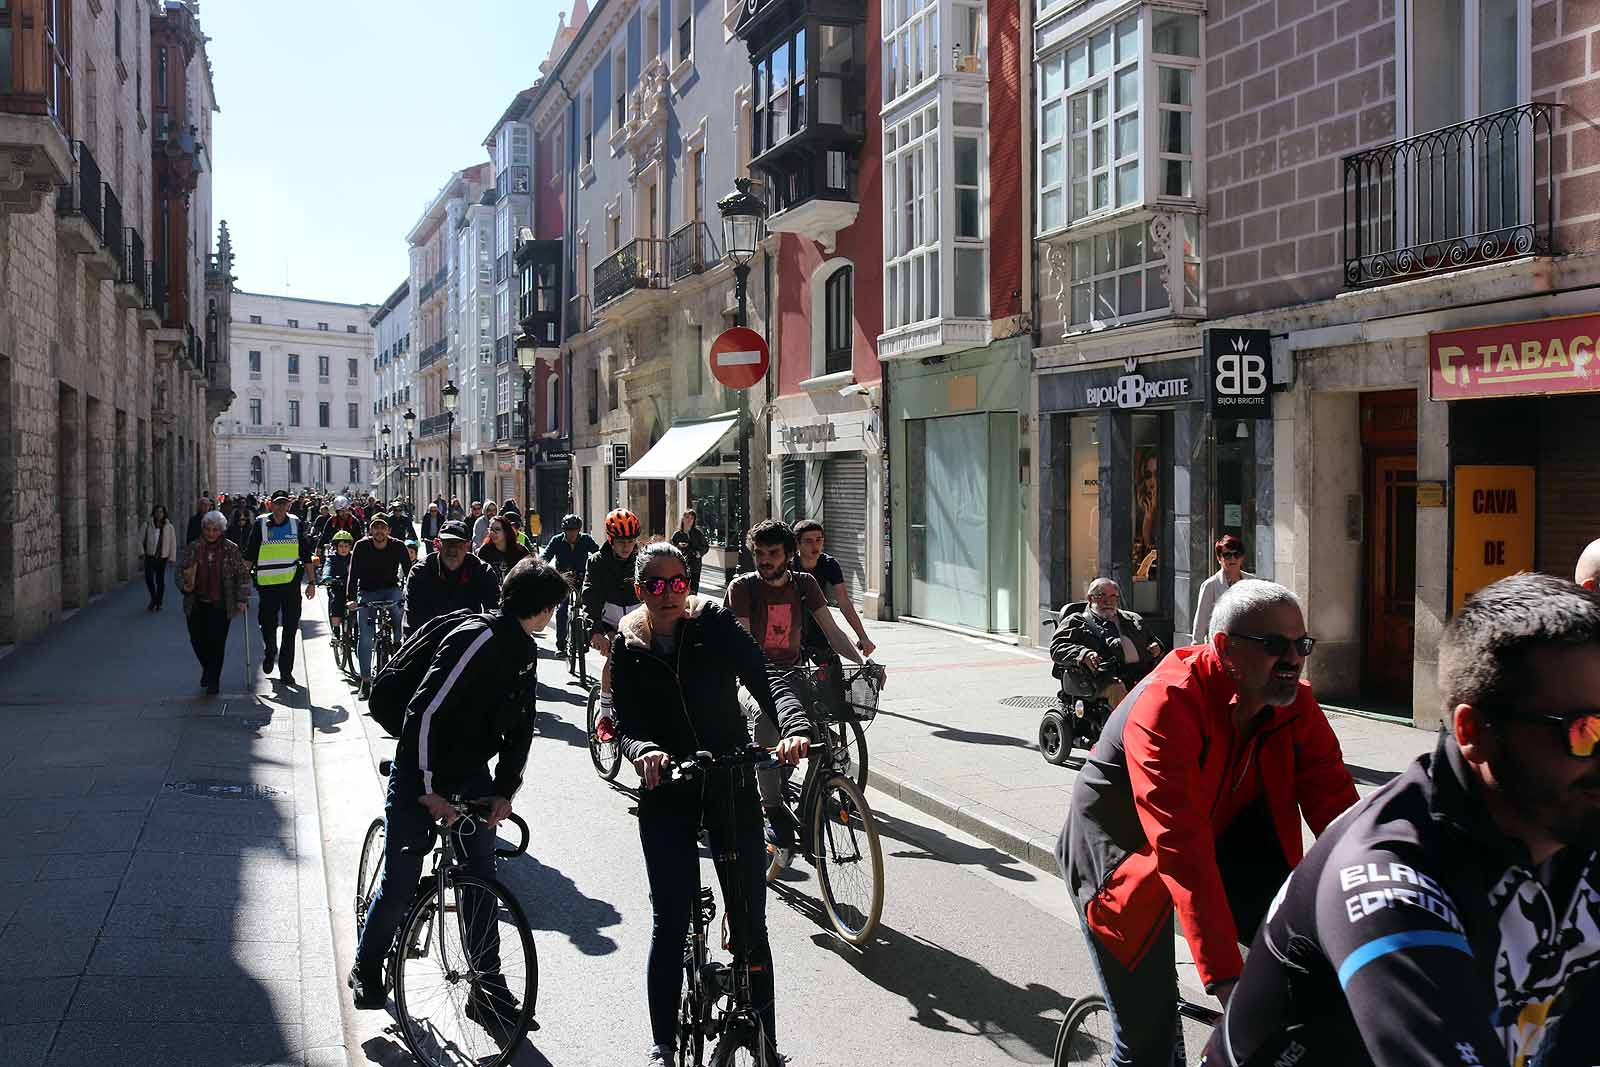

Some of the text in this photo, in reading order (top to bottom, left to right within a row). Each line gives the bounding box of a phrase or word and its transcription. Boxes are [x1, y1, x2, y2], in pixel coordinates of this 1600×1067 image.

[1477, 335, 1600, 373] TABAC
[1086, 386, 1118, 407] BIJOU
[1217, 397, 1265, 405] BIJOU BRIGITTE
[1472, 488, 1518, 514] CAVA
[1484, 540, 1505, 566] DE
